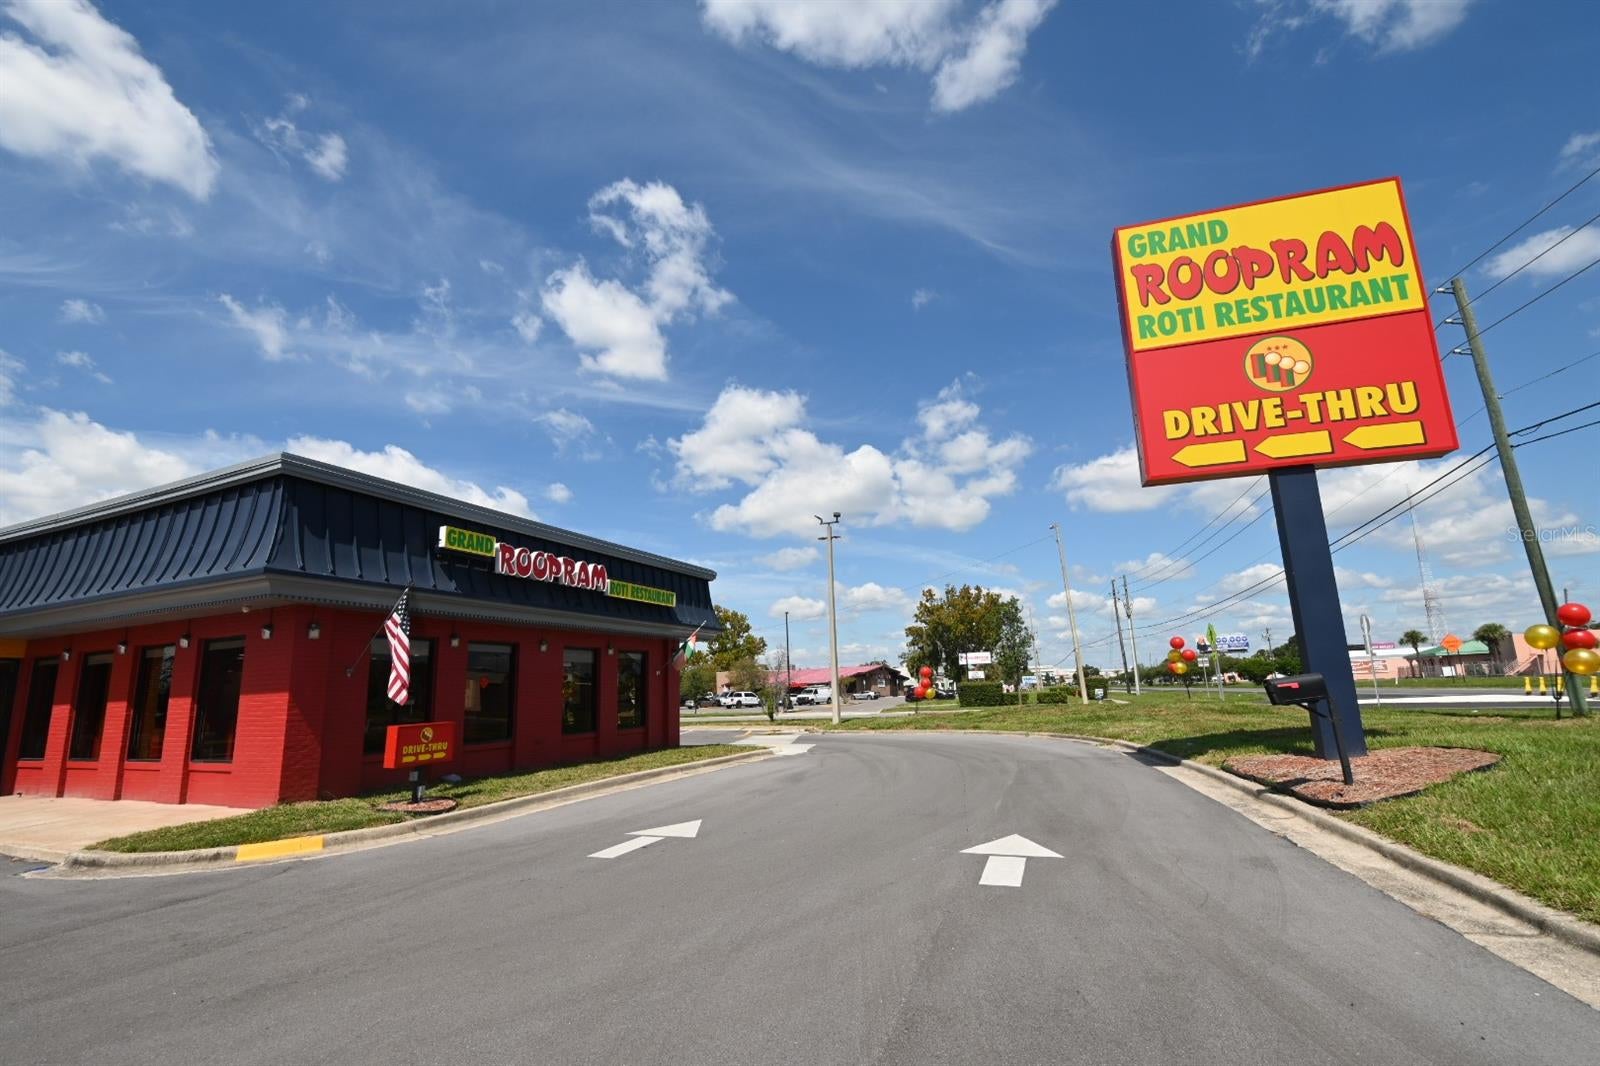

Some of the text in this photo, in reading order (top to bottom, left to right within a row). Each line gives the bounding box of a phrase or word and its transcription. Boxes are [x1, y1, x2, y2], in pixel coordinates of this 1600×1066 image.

[1127, 219, 1229, 259] GRAND
[1131, 222, 1404, 307] ROOPRAM
[1137, 274, 1410, 340] ROTI RESTAURANT
[1163, 380, 1420, 440] DRIVE-THRU
[447, 528, 675, 606] GRAND ROOPRAM ROTI RESTAURANT
[402, 741, 448, 754] DRIVE-THRU
